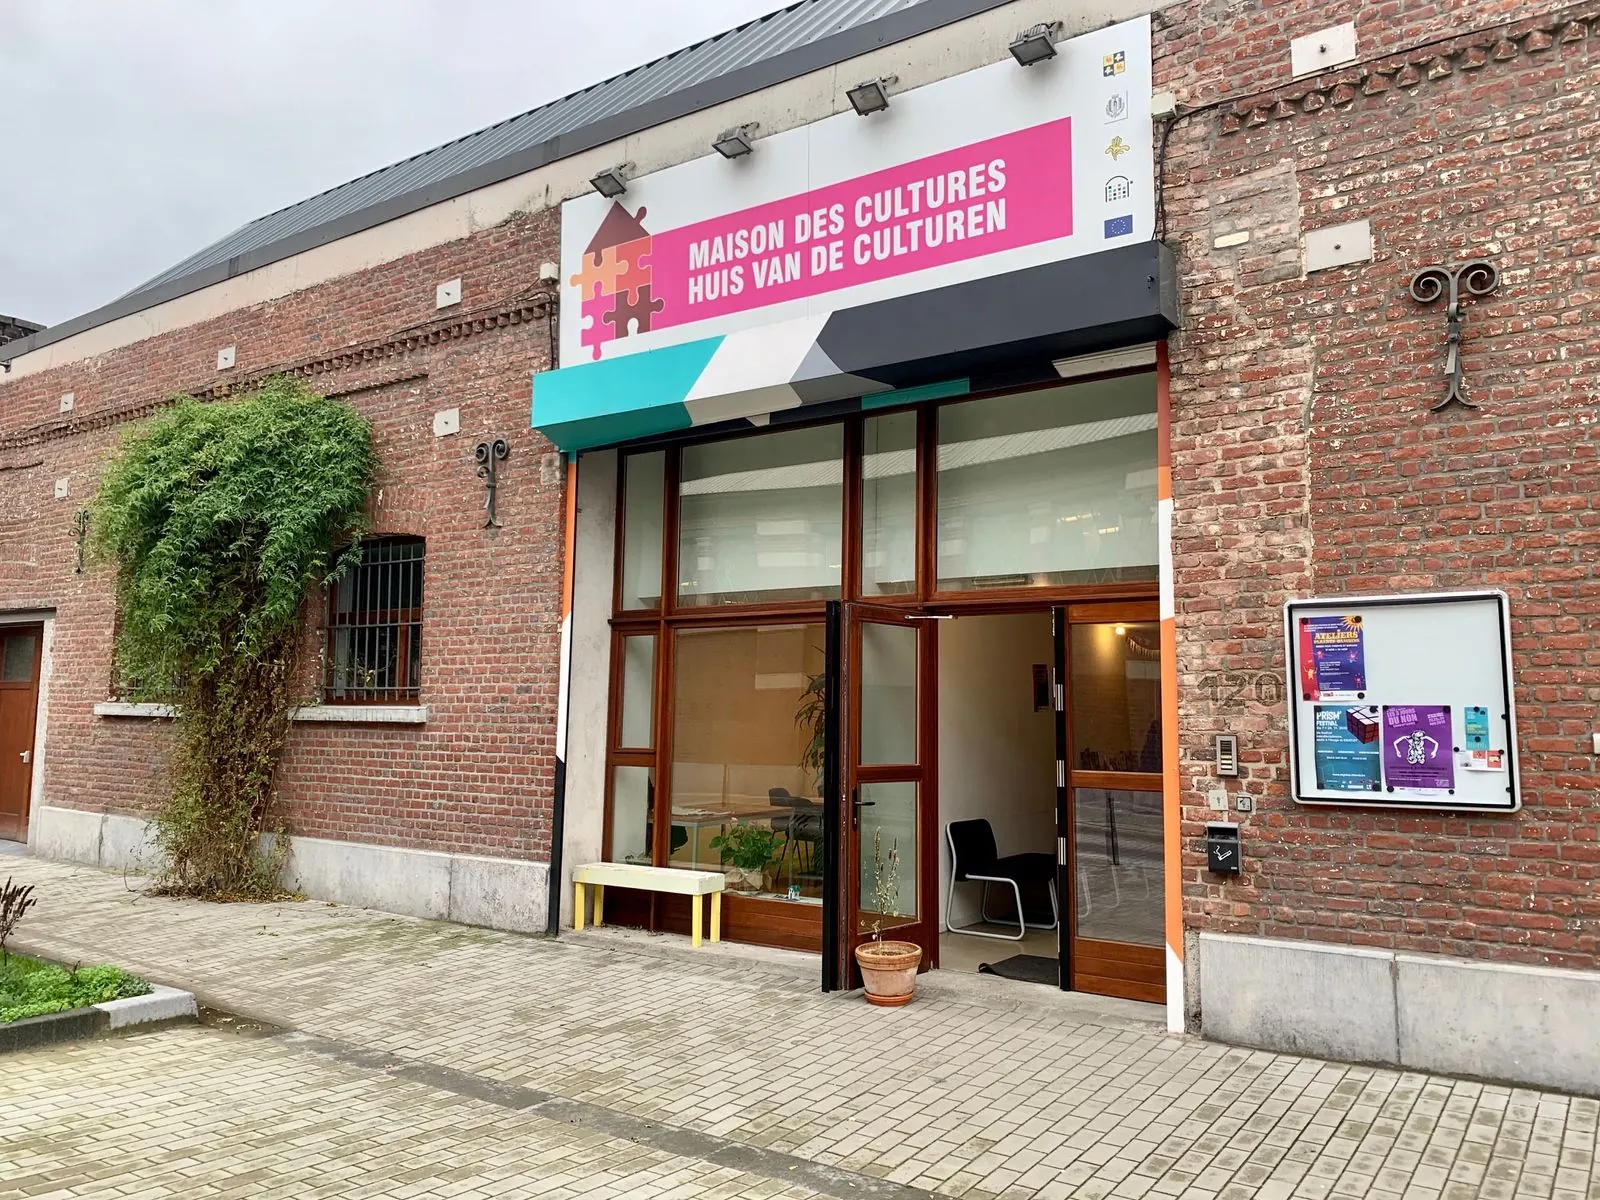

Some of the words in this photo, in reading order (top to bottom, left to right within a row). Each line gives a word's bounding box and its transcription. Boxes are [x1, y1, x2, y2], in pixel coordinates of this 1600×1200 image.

[689, 219, 784, 271] MAISON
[795, 203, 845, 244] DES
[854, 158, 1007, 228] CULTURES
[688, 265, 744, 305] HUIS
[752, 251, 801, 289] VAN
[811, 240, 844, 277] DE
[853, 197, 1006, 265] CULTUREN
[1314, 629, 1358, 640] ATELIERS
[1197, 673, 1283, 707] 120
